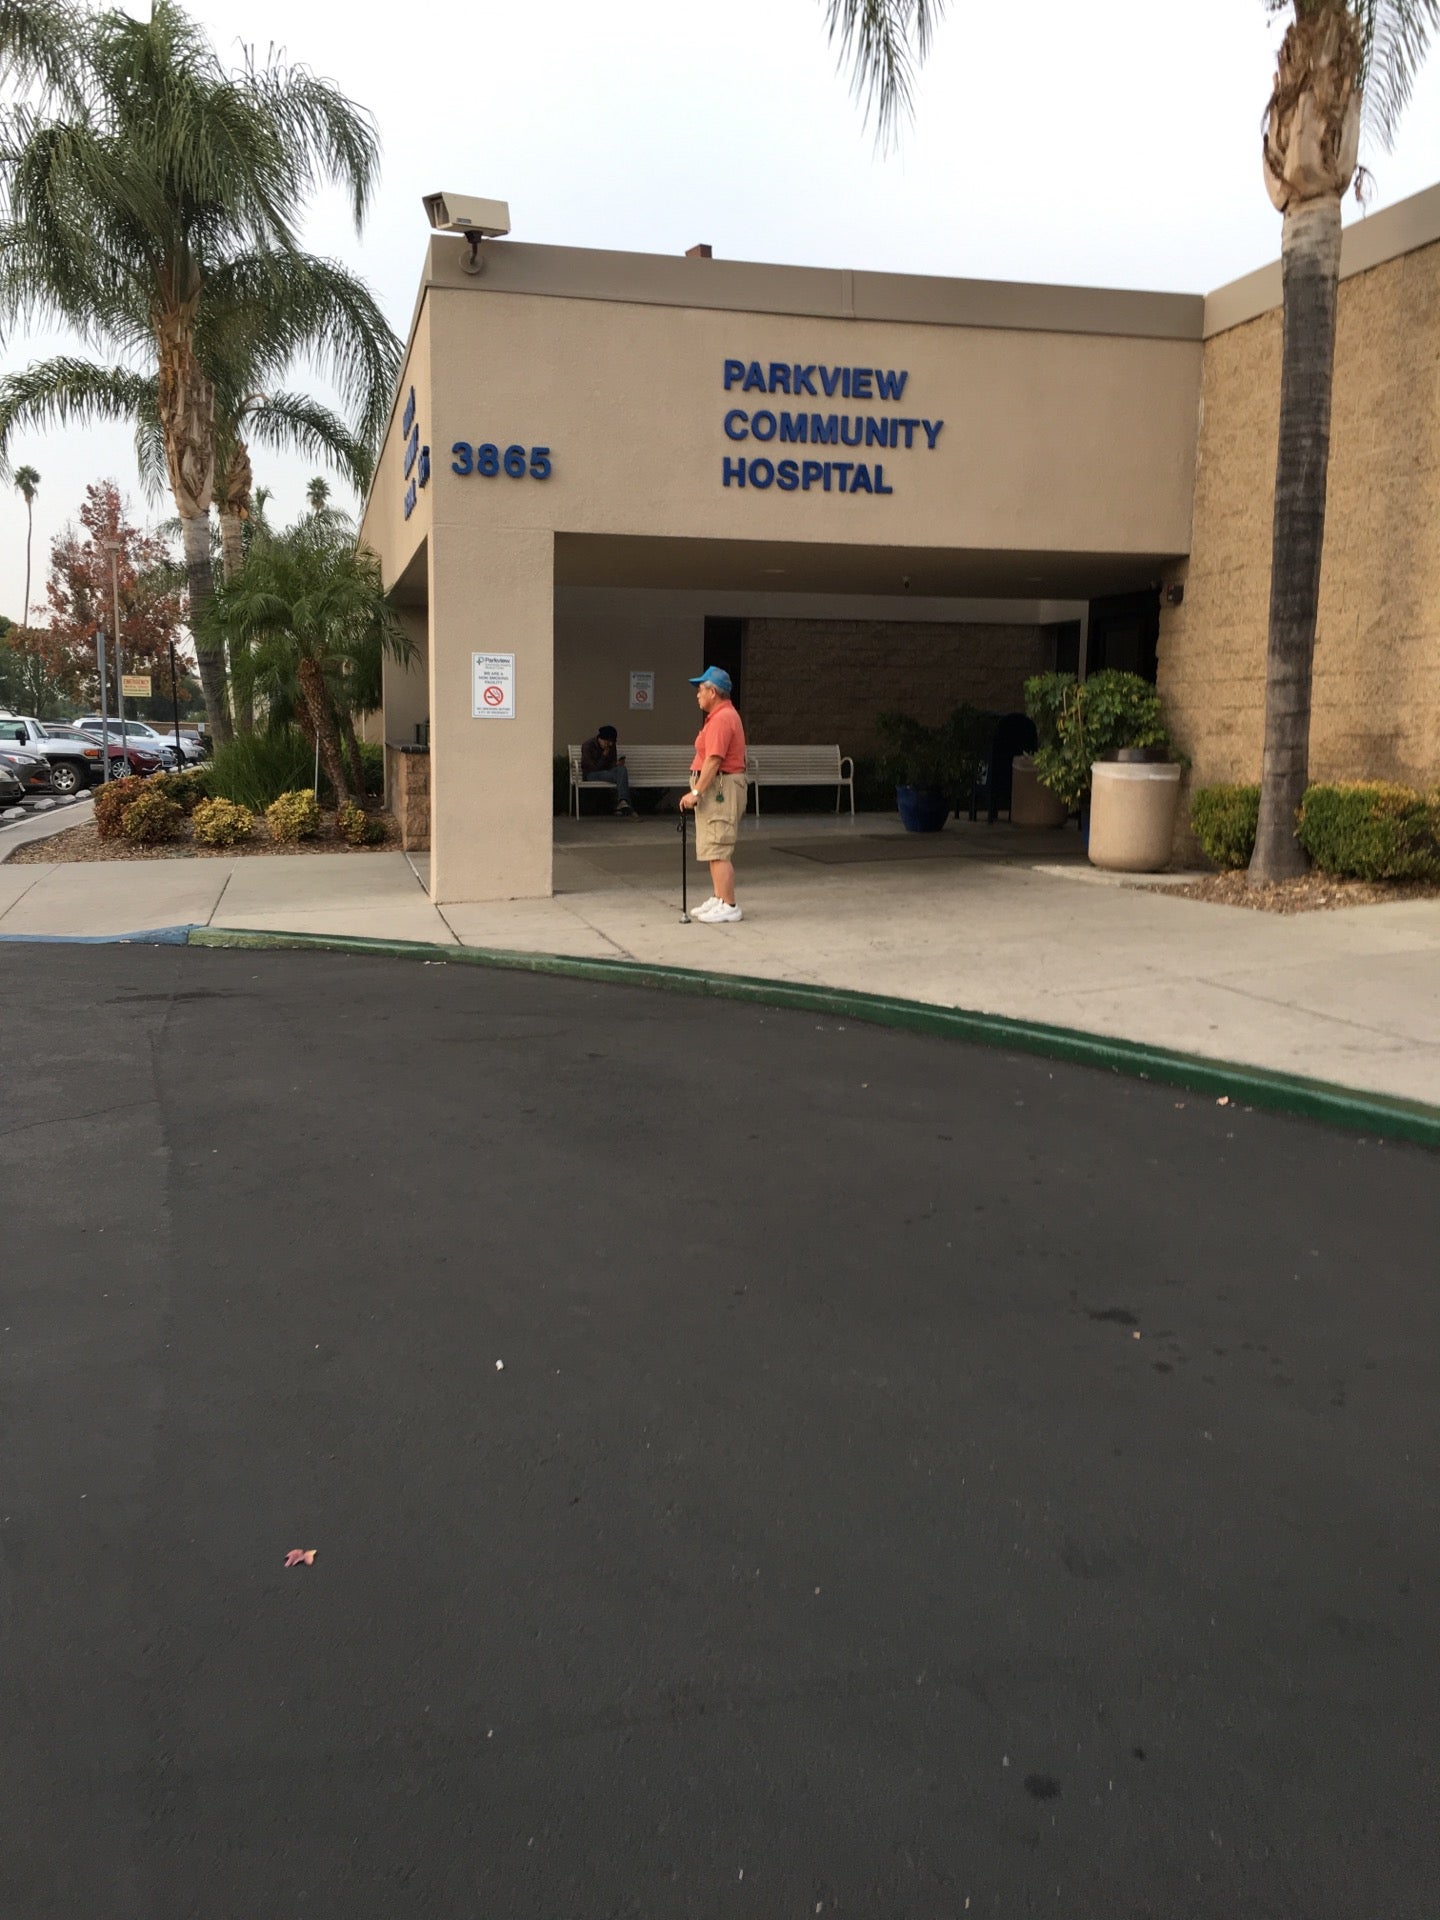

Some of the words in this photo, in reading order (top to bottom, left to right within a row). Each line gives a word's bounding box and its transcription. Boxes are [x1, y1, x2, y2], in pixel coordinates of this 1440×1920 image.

[723, 359, 909, 401] PARKVIEW
[724, 409, 944, 449] COMMUNITY
[451, 441, 552, 480] 3865
[722, 456, 893, 495] HOSPITAL
